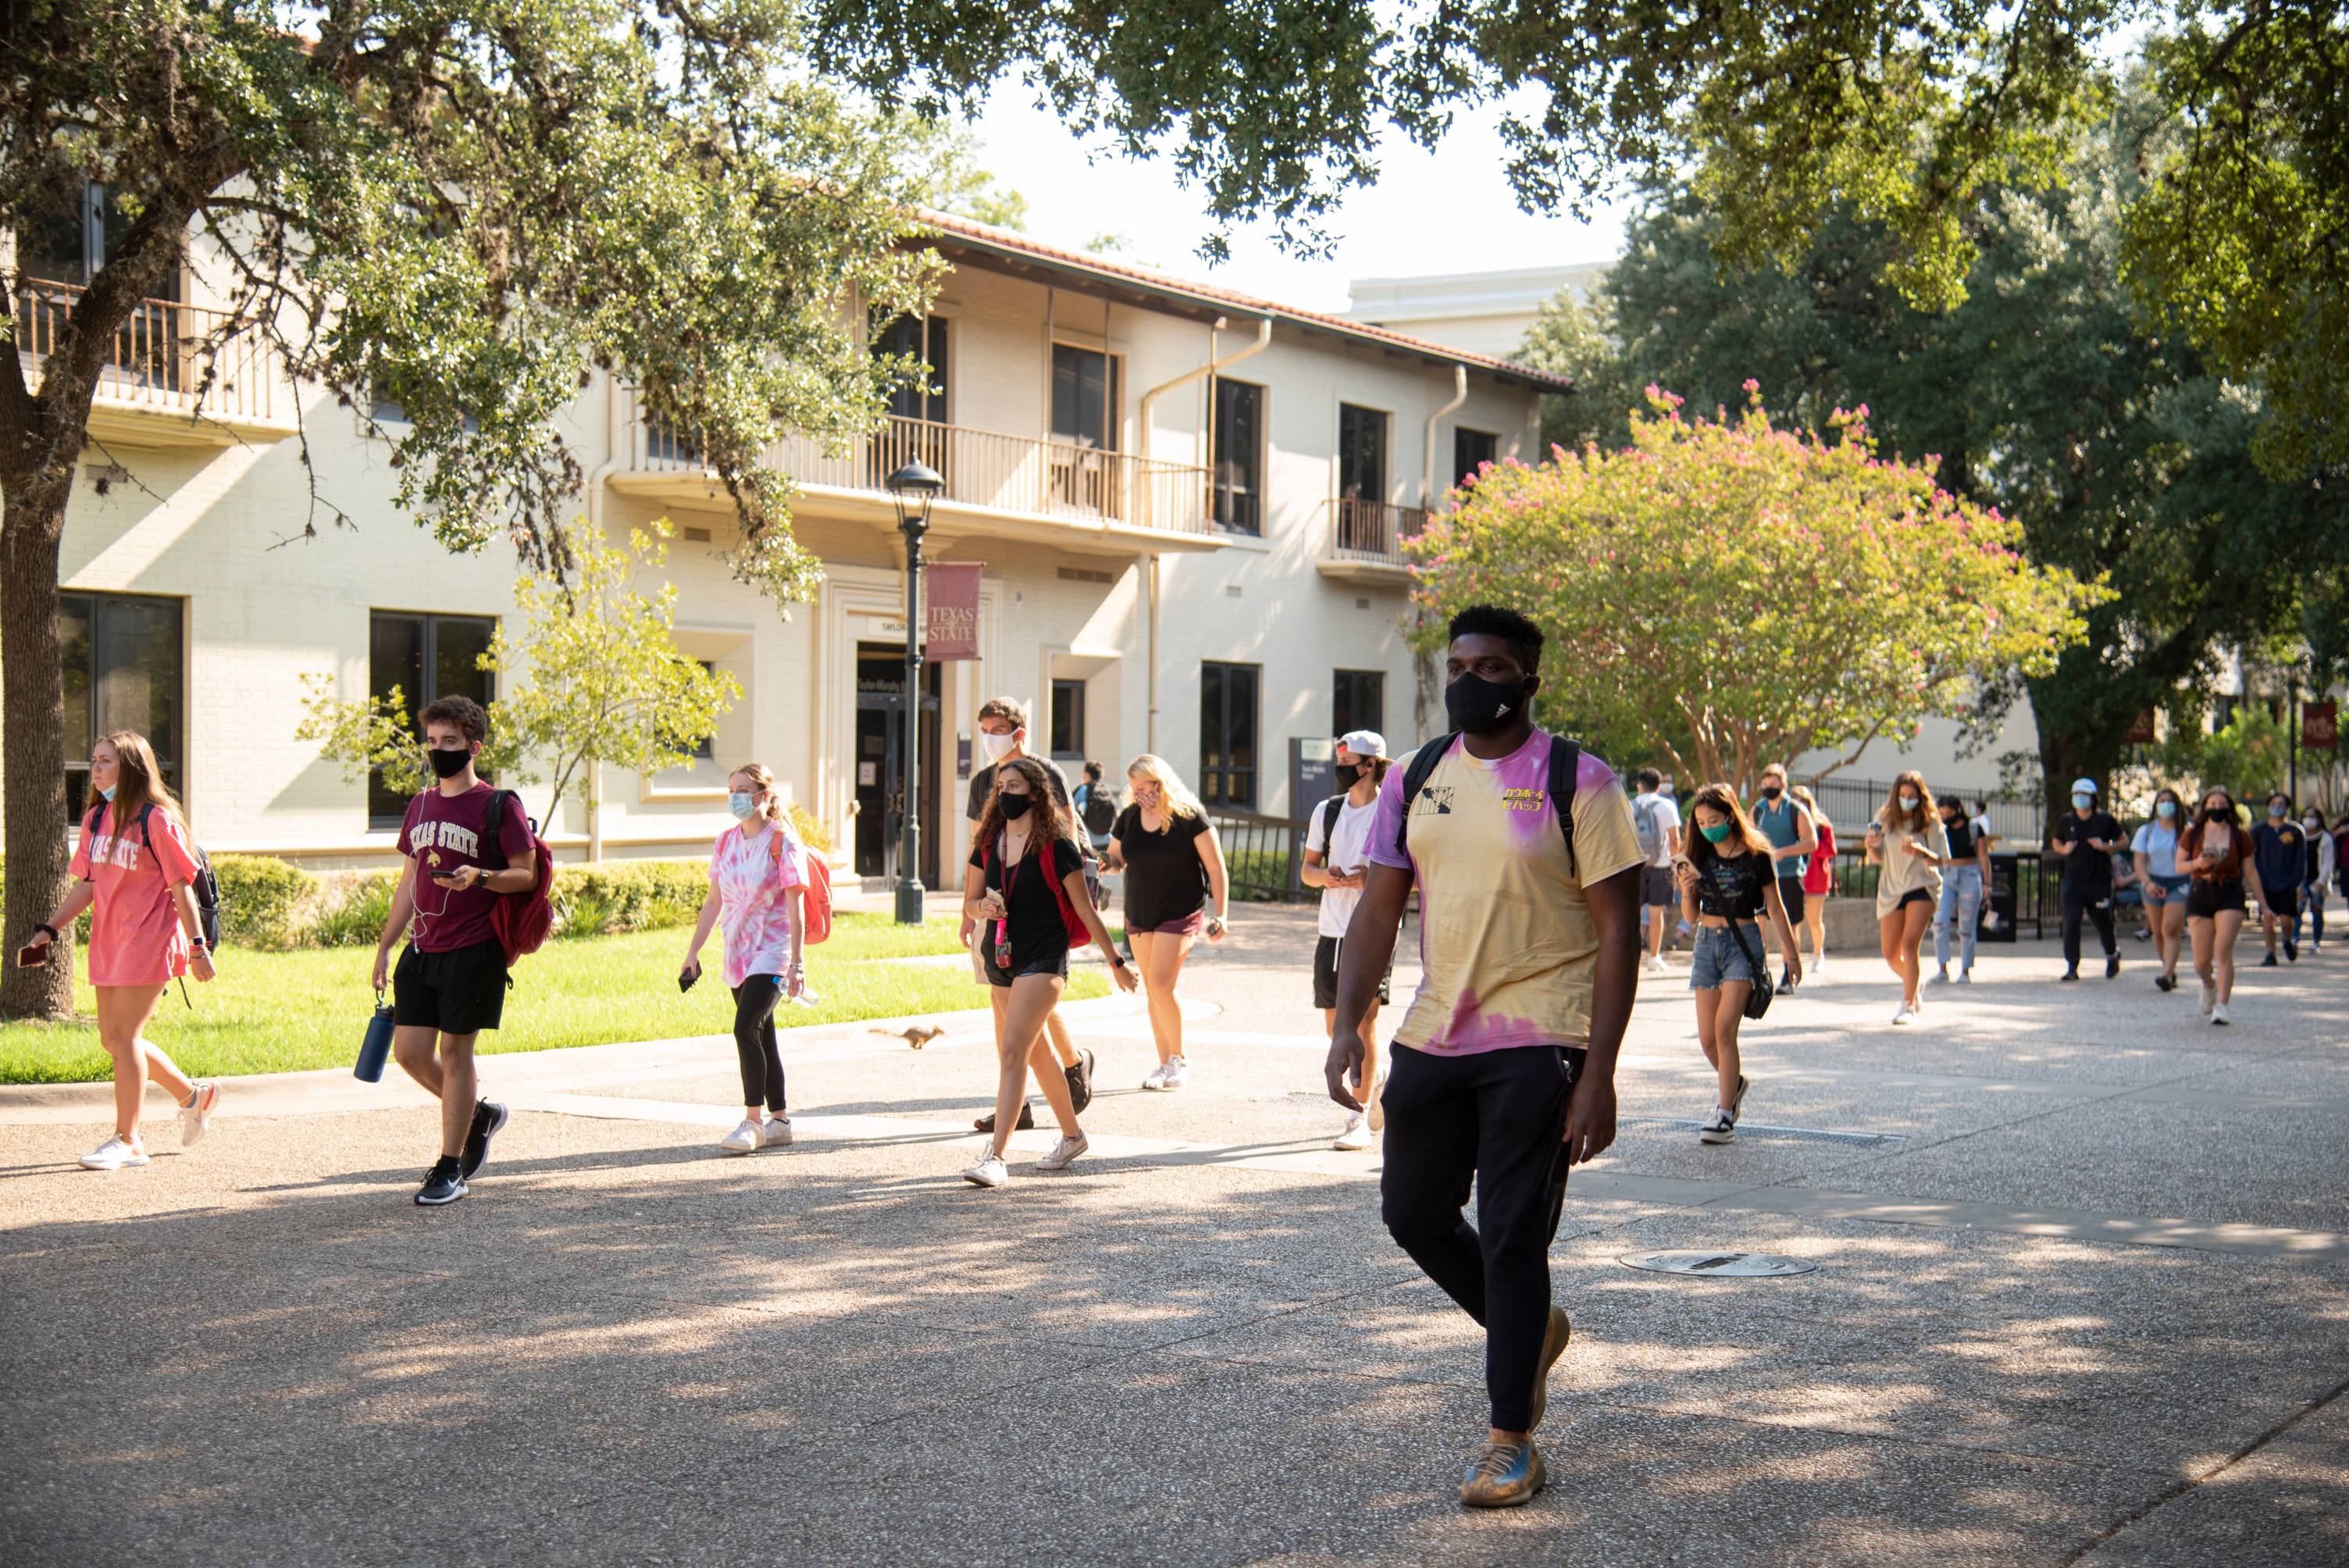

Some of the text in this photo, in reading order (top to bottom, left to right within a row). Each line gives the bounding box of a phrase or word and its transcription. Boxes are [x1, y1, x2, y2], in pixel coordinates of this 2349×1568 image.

[929, 606, 975, 622] TEXAS
[929, 625, 974, 641] STATE
[437, 821, 478, 858] STATE
